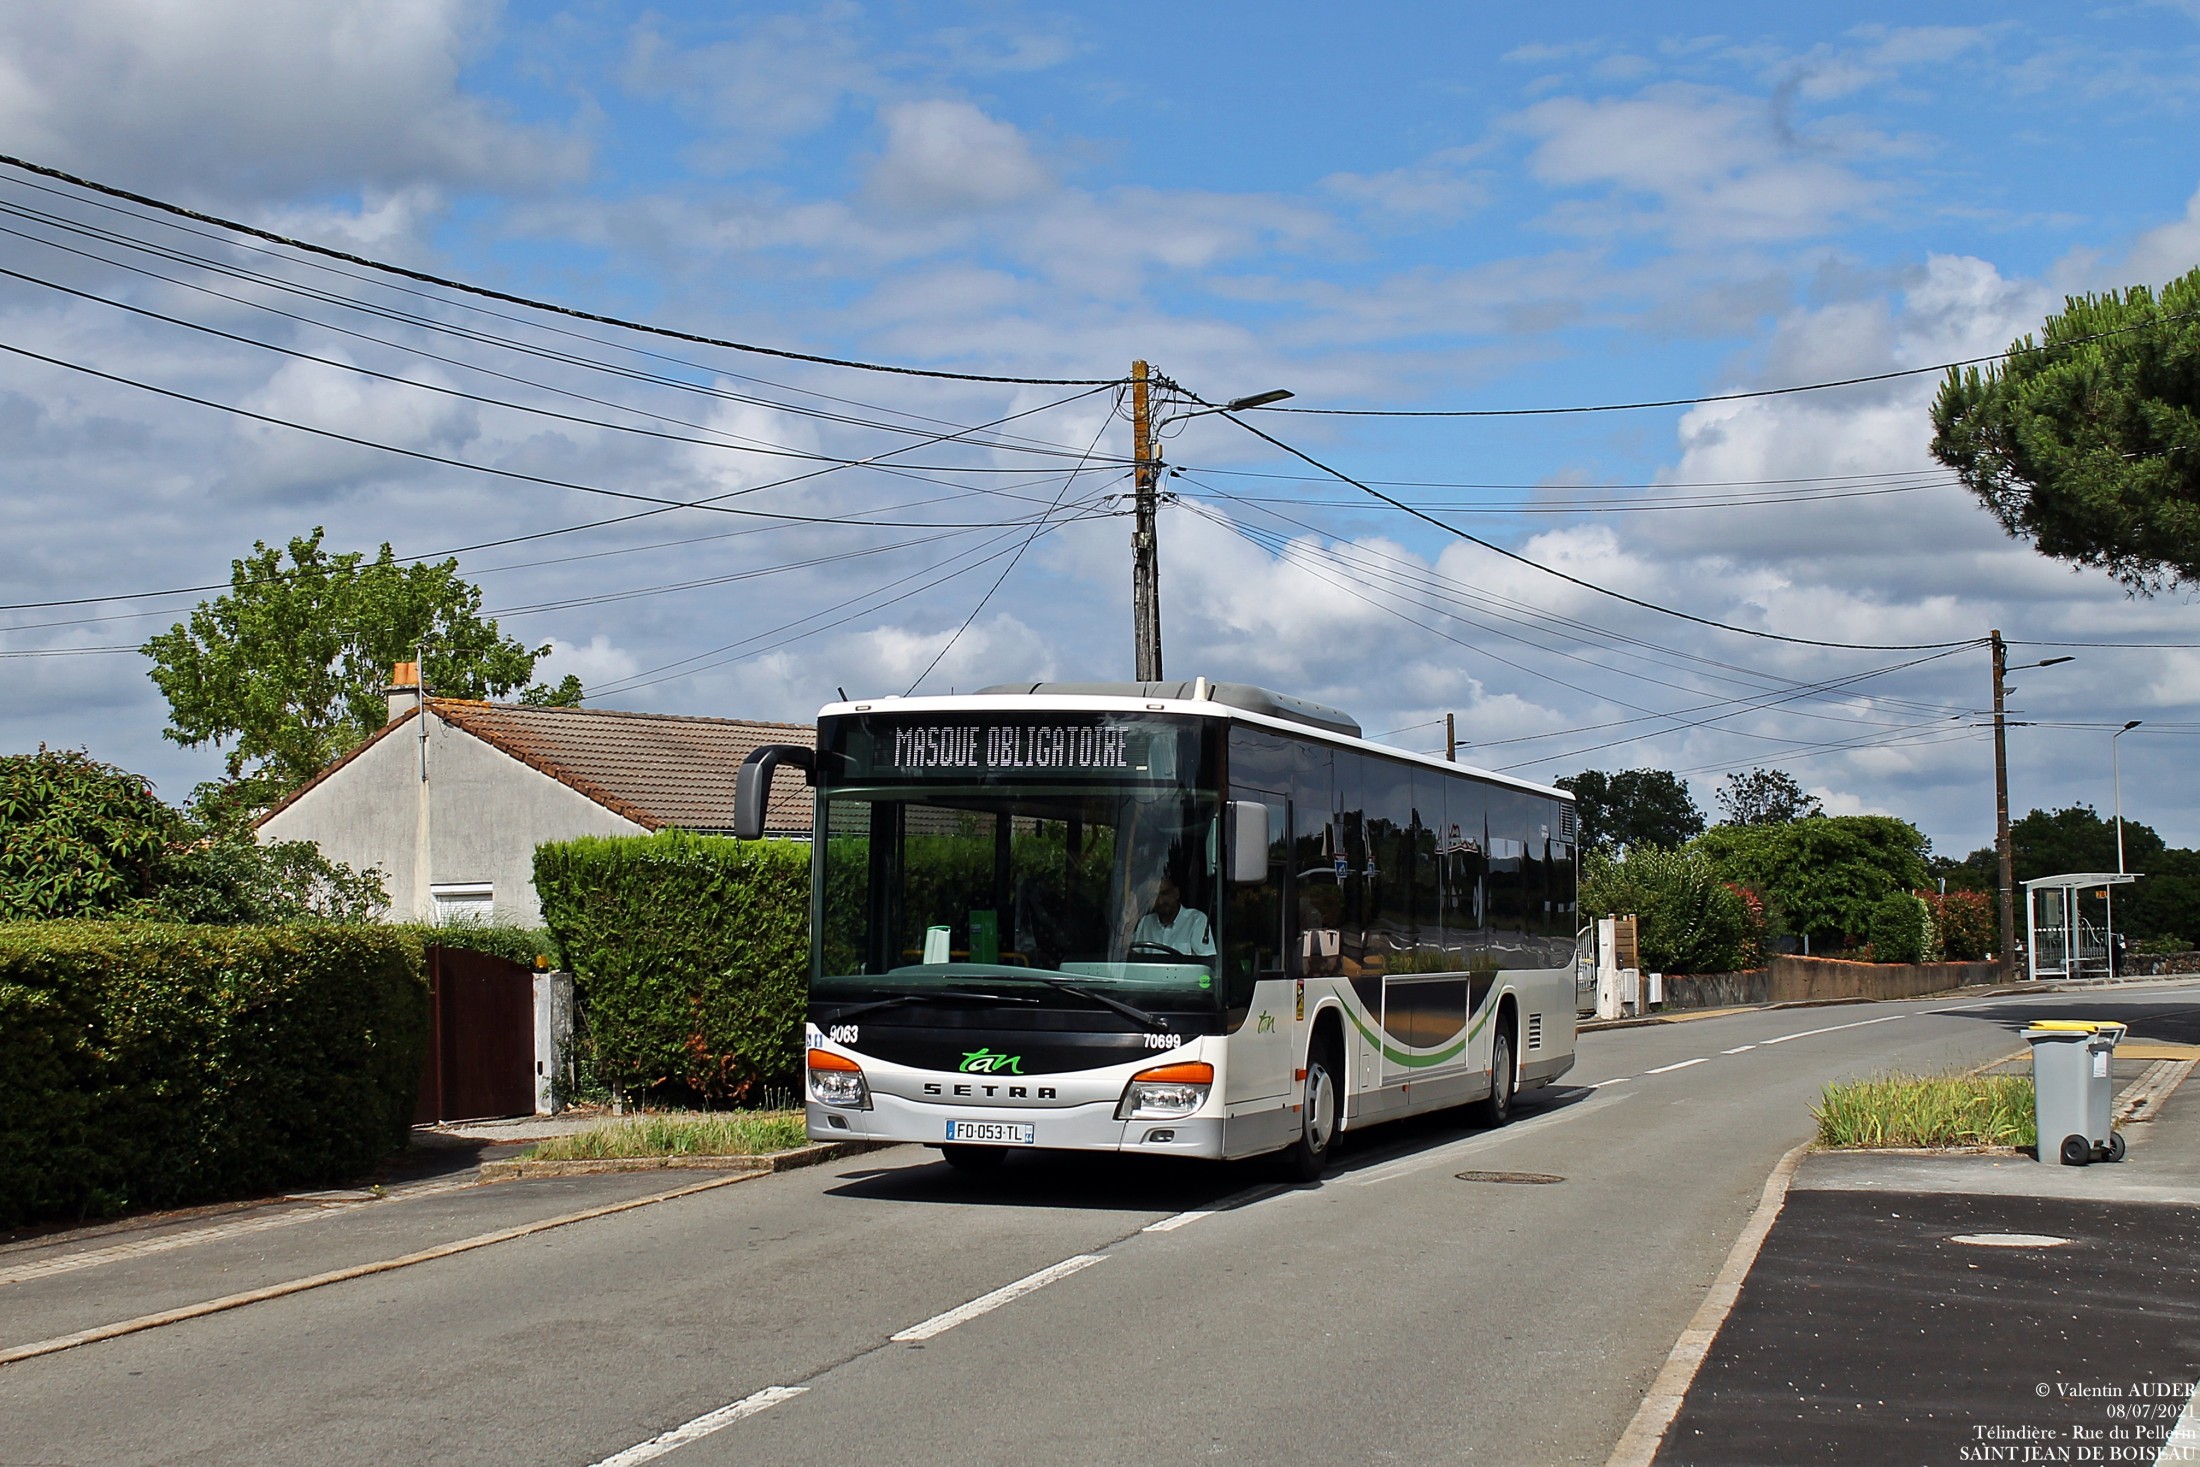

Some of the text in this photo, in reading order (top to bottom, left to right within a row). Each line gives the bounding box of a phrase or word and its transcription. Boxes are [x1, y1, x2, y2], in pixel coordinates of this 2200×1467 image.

[894, 726, 1129, 767] MASQUE OBLIGATOIRE
[829, 1024, 859, 1043] 9063
[1143, 1033, 1181, 1049] 70699
[959, 1047, 1025, 1074] tan
[923, 1083, 1057, 1100] SETRA
